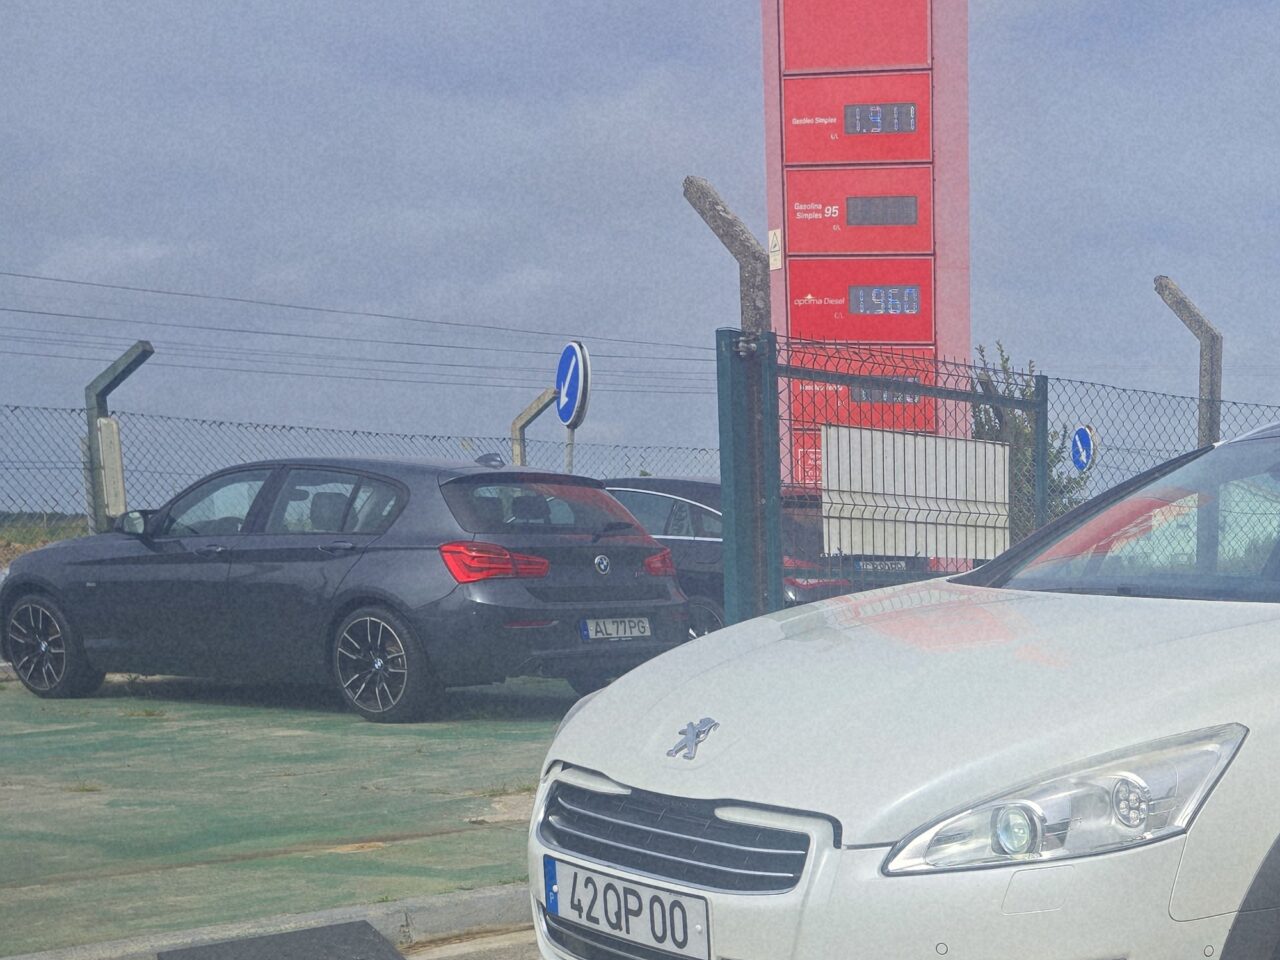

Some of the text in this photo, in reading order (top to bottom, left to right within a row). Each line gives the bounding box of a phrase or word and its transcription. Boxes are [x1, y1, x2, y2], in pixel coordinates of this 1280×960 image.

[794, 202, 822, 210] Gasolina
[796, 212, 822, 220] Simples
[824, 206, 839, 217] 95
[823, 297, 845, 305] Diesel
[859, 288, 918, 314] 1.960
[594, 619, 647, 636] AL77PG
